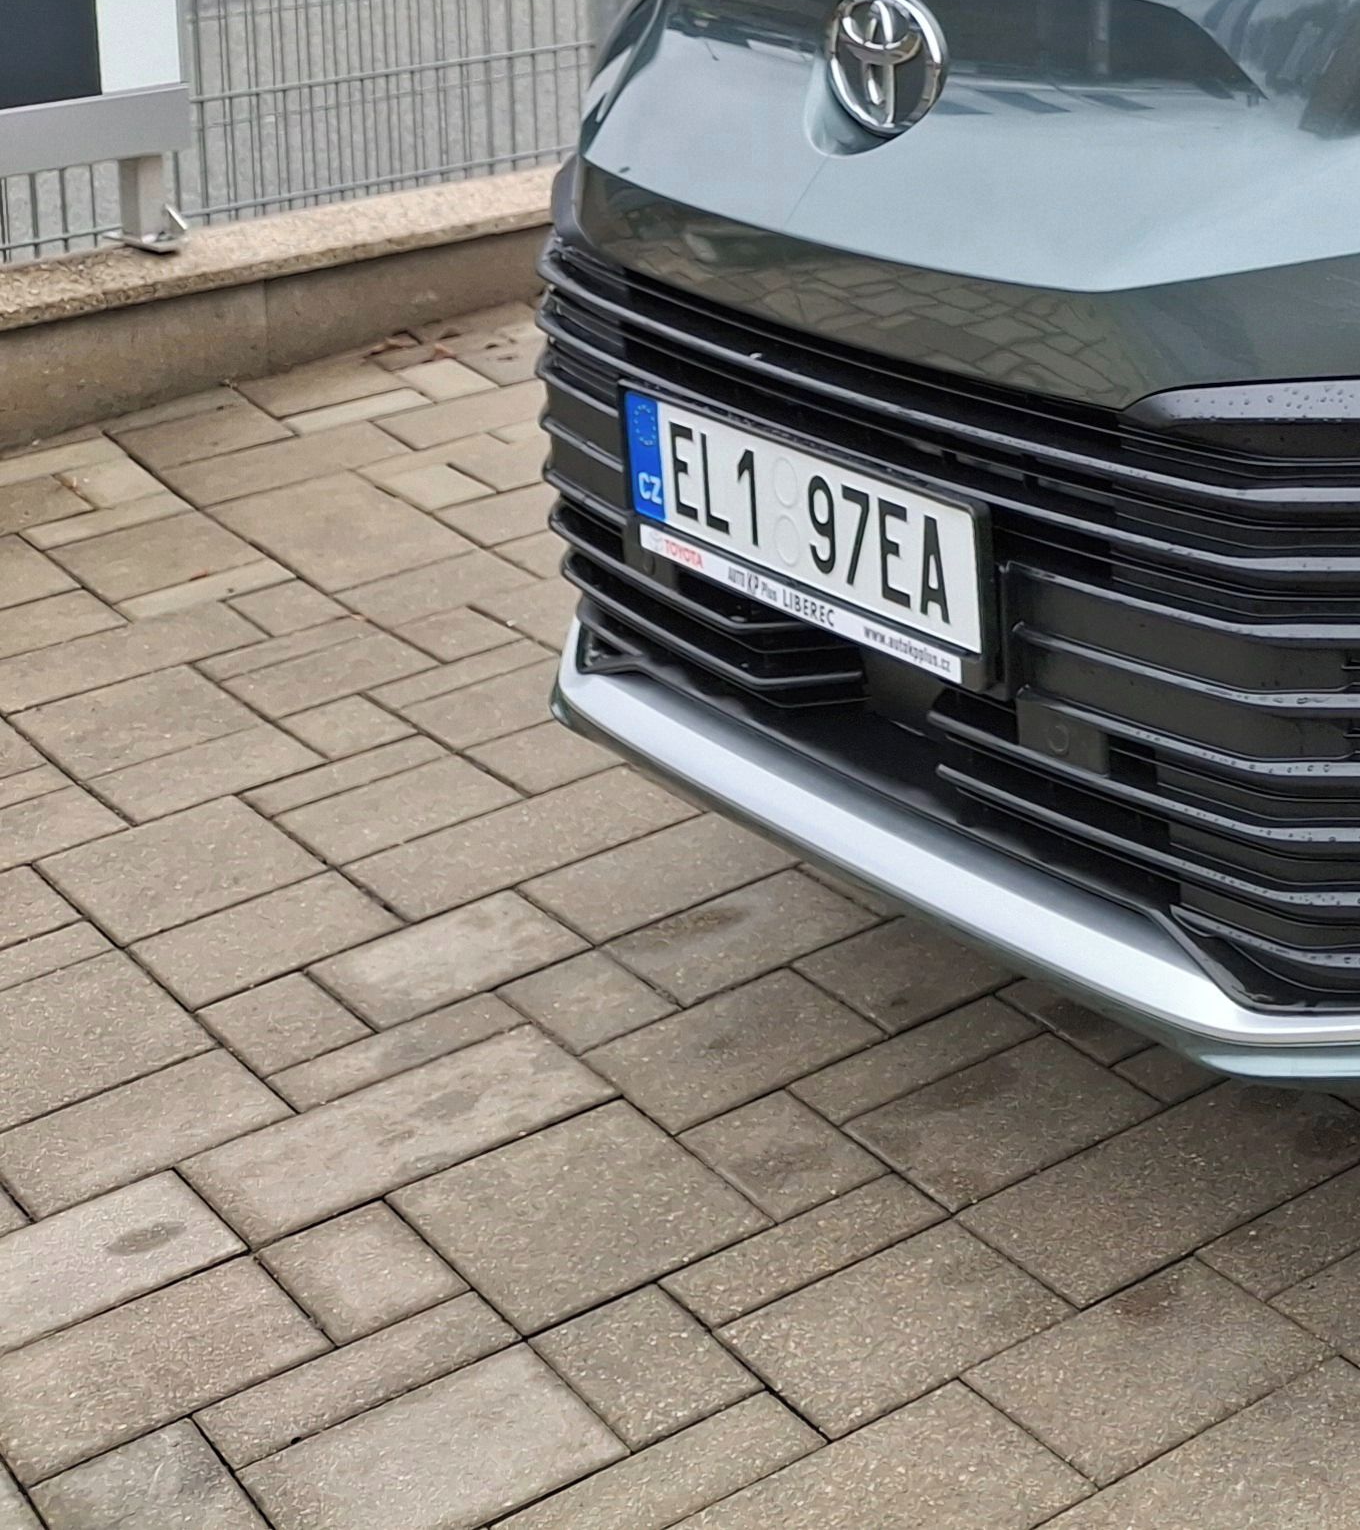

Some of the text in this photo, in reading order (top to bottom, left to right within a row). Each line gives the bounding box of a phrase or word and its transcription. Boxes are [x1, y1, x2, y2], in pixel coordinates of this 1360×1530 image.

[638, 470, 664, 505] CZ
[668, 421, 951, 625] EL1 97EA
[662, 538, 704, 569] TOYOTA
[782, 588, 835, 627] LIBEREC
